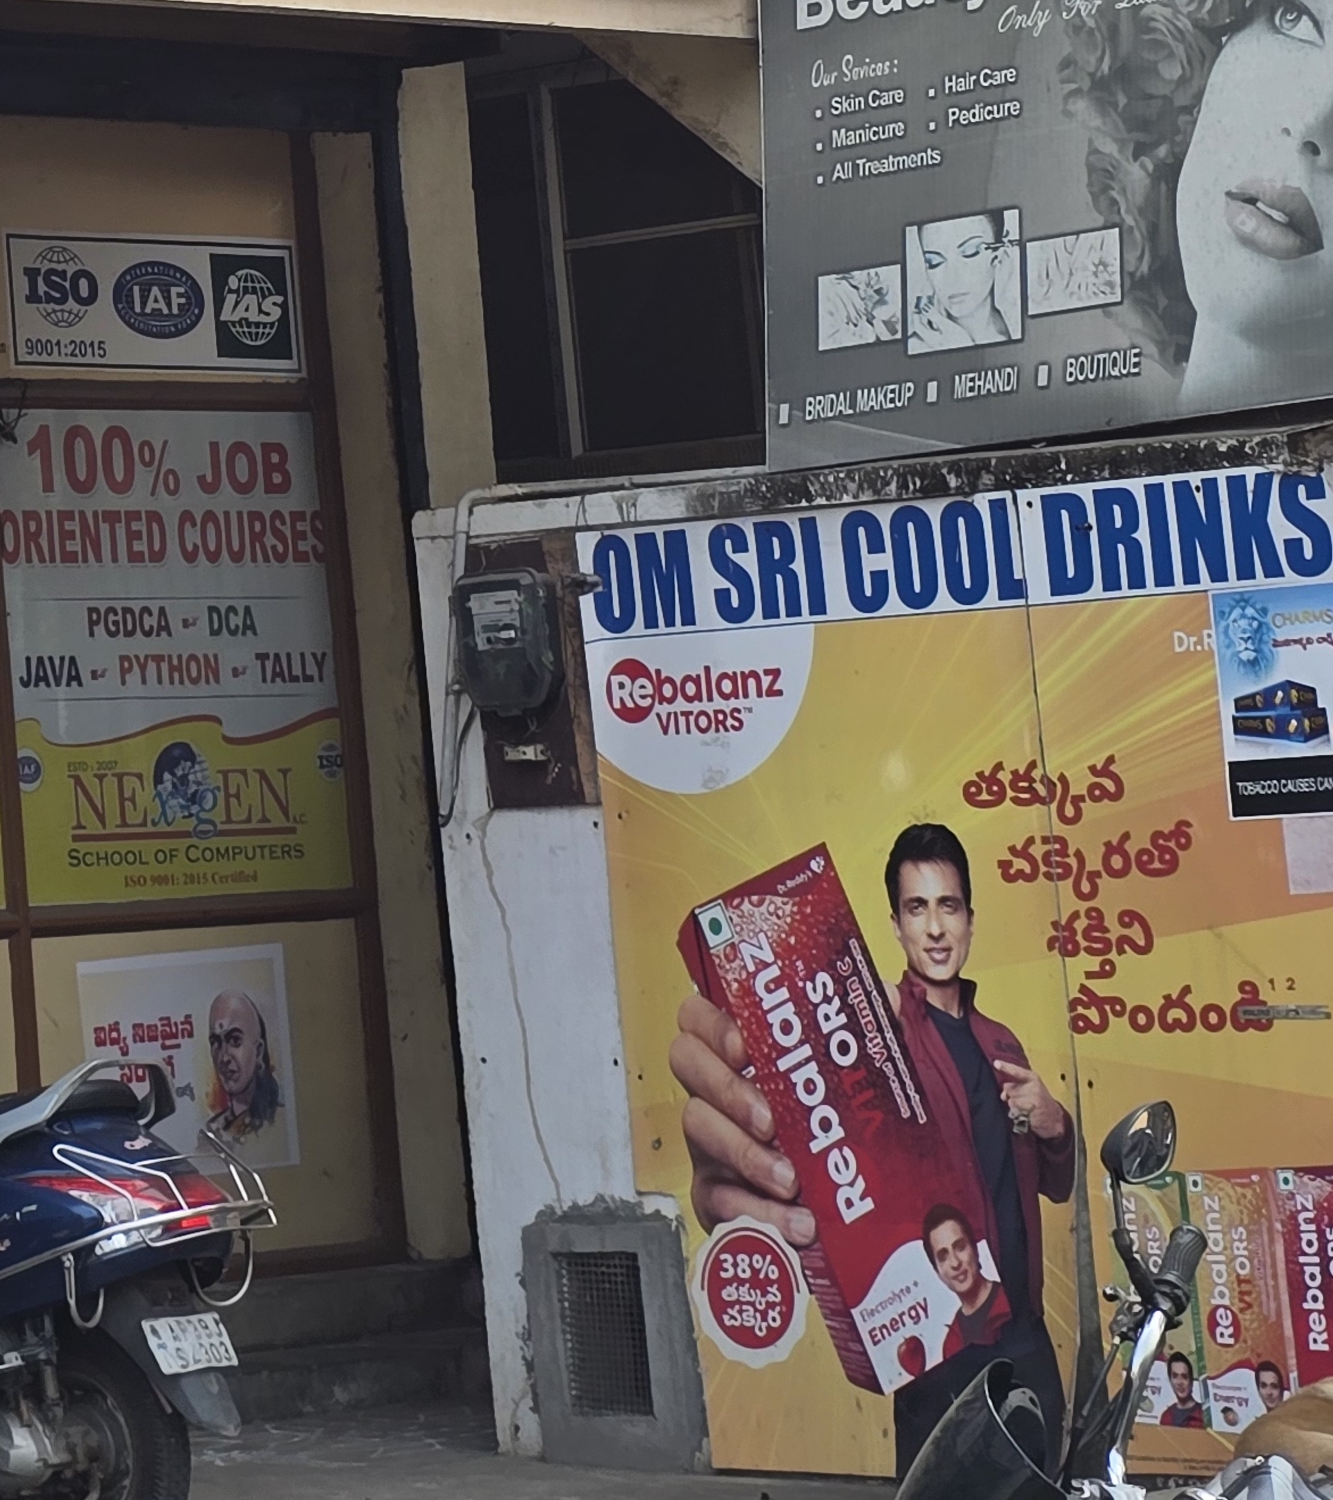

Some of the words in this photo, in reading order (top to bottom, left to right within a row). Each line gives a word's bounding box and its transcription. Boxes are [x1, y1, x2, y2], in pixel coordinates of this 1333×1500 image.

[944, 72, 976, 95] Hair
[980, 65, 1017, 88] Care
[831, 94, 864, 116] Skin
[868, 87, 904, 110] Care
[948, 98, 1021, 128] Pedicure
[831, 120, 905, 150] Manicure
[832, 162, 852, 182] All
[856, 148, 941, 178] Treatments
[25, 339, 107, 359] 9001:2015
[1066, 348, 1141, 383] BOUTIQUE
[954, 367, 1018, 400] MEHANDI
[805, 394, 853, 422] BRIDAL
[856, 383, 914, 417] MAKEUP
[27, 424, 180, 496] 100%
[197, 441, 293, 495] JOB
[1, 509, 167, 564] ORIENTED
[178, 509, 325, 564] COURSES
[592, 531, 697, 634] OM
[709, 517, 827, 623] SRI
[841, 498, 1027, 613] COOL
[1041, 471, 1333, 598] DRINKS
[606, 657, 784, 724] Rebalanz
[963, 754, 1125, 826] తక్కువ
[997, 819, 1193, 902] చక్కెరతో
[1046, 906, 1155, 980] శక్తిని
[719, 1254, 780, 1280] 38%
